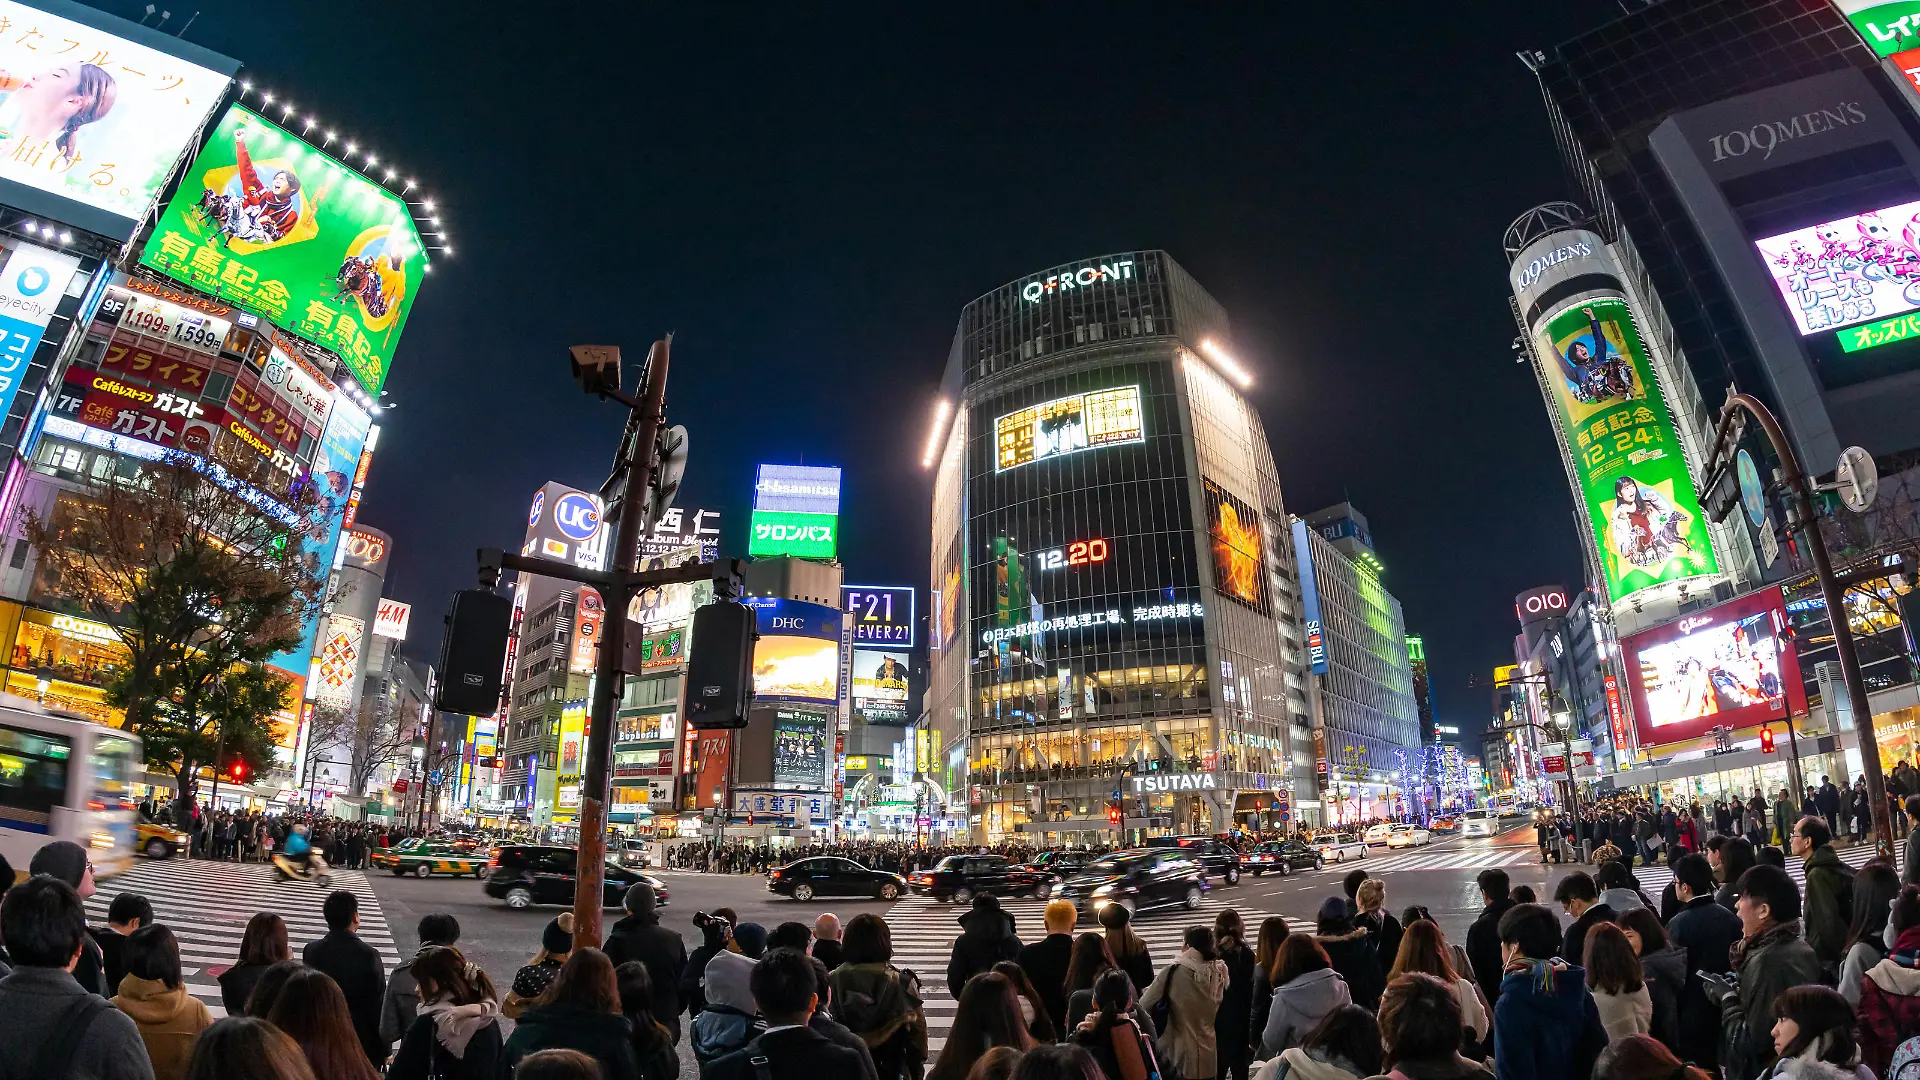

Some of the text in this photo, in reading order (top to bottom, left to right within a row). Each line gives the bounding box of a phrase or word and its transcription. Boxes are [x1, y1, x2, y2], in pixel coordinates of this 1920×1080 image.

[0, 130, 130, 197] 届ける。
[153, 251, 190, 274] 1224
[194, 271, 223, 289] SUN
[159, 229, 292, 310] 有馬記念
[102, 298, 125, 314] 9F
[126, 276, 232, 317] しゃぶしゃぶバイキング
[174, 321, 221, 350] 1,599円
[301, 319, 335, 342] 1224
[1853, 315, 1920, 349] オッズパ
[106, 346, 208, 389] プライス
[57, 394, 83, 411] 7F
[86, 402, 114, 418] Café
[152, 392, 205, 420] ガスト
[230, 383, 298, 442] コンタクト
[111, 409, 176, 442] ガスト
[1575, 406, 1658, 450] 有馬記念
[1582, 427, 1654, 470] 12.24
[270, 449, 303, 479] ガスト
[560, 502, 597, 531] UC
[647, 533, 680, 545] lbum
[755, 522, 833, 543] サロンパス
[577, 550, 597, 564] VISA
[1037, 538, 1108, 571] 12.20
[376, 602, 407, 625] H&M
[771, 616, 805, 630] DHC
[894, 625, 909, 640] 21
[1306, 620, 1324, 666] SEIBU
[839, 666, 849, 701] neon
[882, 679, 907, 689] MARS
[1132, 773, 1216, 792] TSUTAYA
